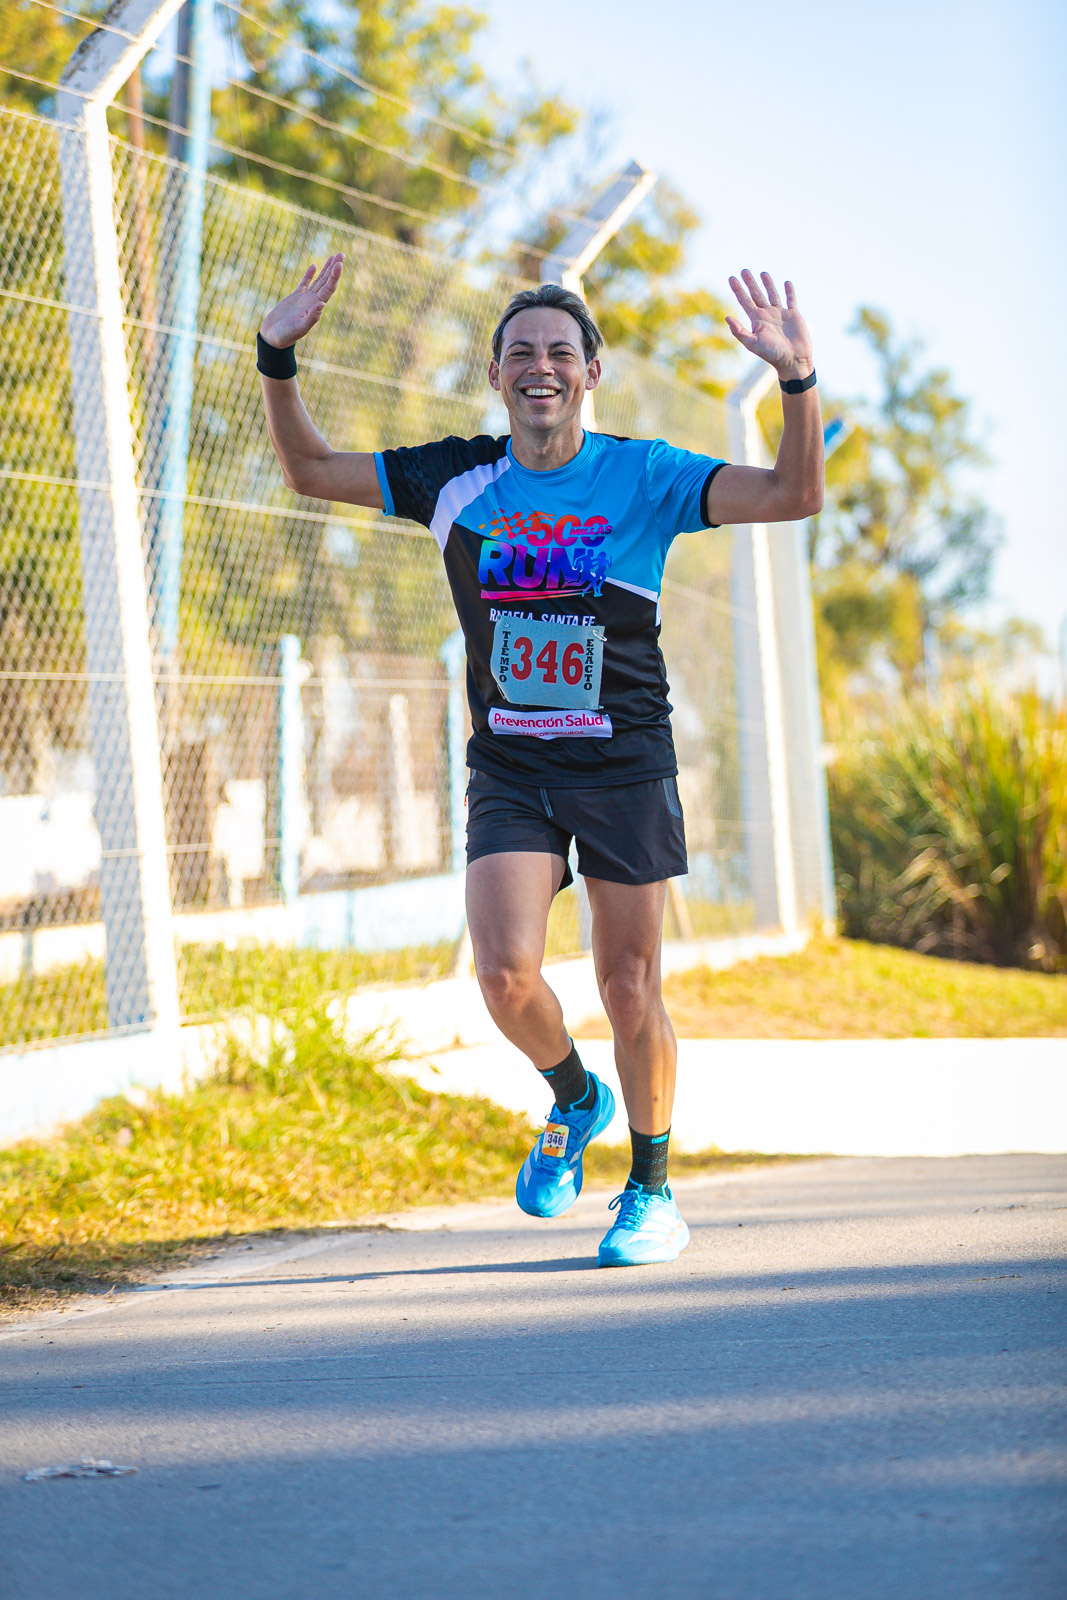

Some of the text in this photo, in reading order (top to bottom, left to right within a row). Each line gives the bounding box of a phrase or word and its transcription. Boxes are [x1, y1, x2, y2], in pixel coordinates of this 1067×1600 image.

[569, 525, 613, 535] MILLAS
[478, 539, 588, 589] RUN
[541, 613, 579, 627] SANTA
[582, 615, 596, 627] FE
[499, 630, 511, 682] TIEMPO
[511, 636, 585, 685] 346
[583, 639, 595, 691] EXACTO
[494, 712, 604, 728] Prevención Salud
[547, 1133, 564, 1146] 346
